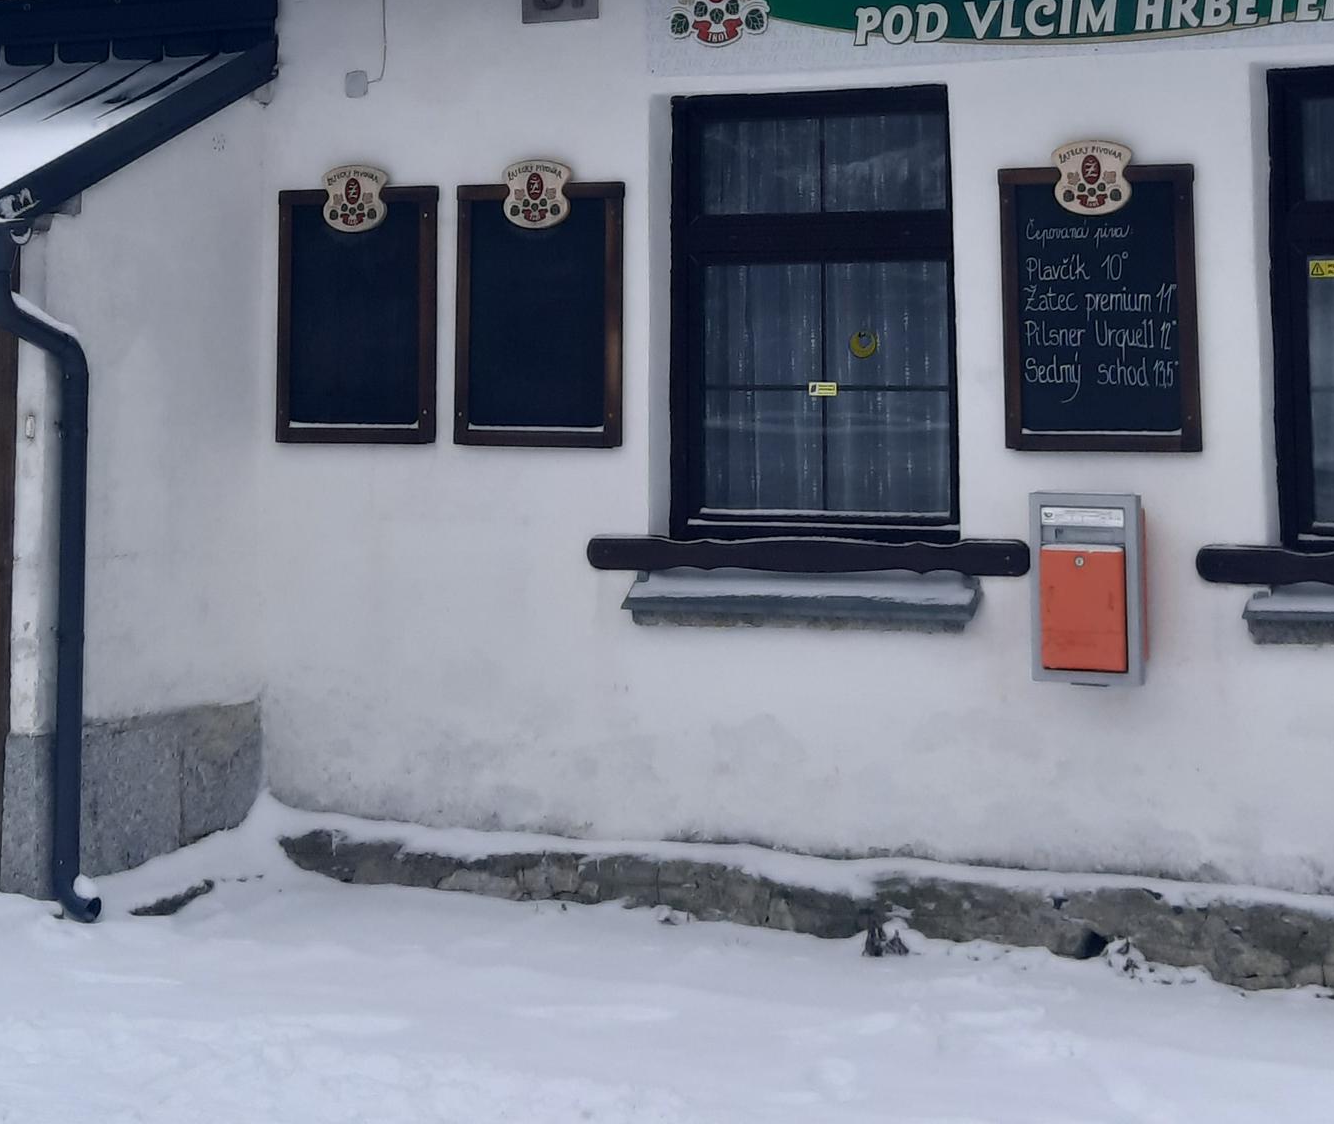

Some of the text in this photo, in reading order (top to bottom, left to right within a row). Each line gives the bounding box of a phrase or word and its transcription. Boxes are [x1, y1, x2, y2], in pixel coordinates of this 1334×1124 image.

[707, 31, 729, 43] 1801
[853, 3, 949, 46] POD
[1091, 145, 1123, 161] PIVOVAR
[1025, 218, 1090, 249] Čepovaná
[1025, 251, 1129, 281] Plavčík 10°
[1023, 284, 1079, 312] Žatec
[1085, 286, 1152, 322] premium
[1024, 319, 1086, 347] Pilsner
[1094, 319, 1155, 363] Urquell
[1024, 351, 1081, 404] Sedmý
[1097, 357, 1150, 388] schod
